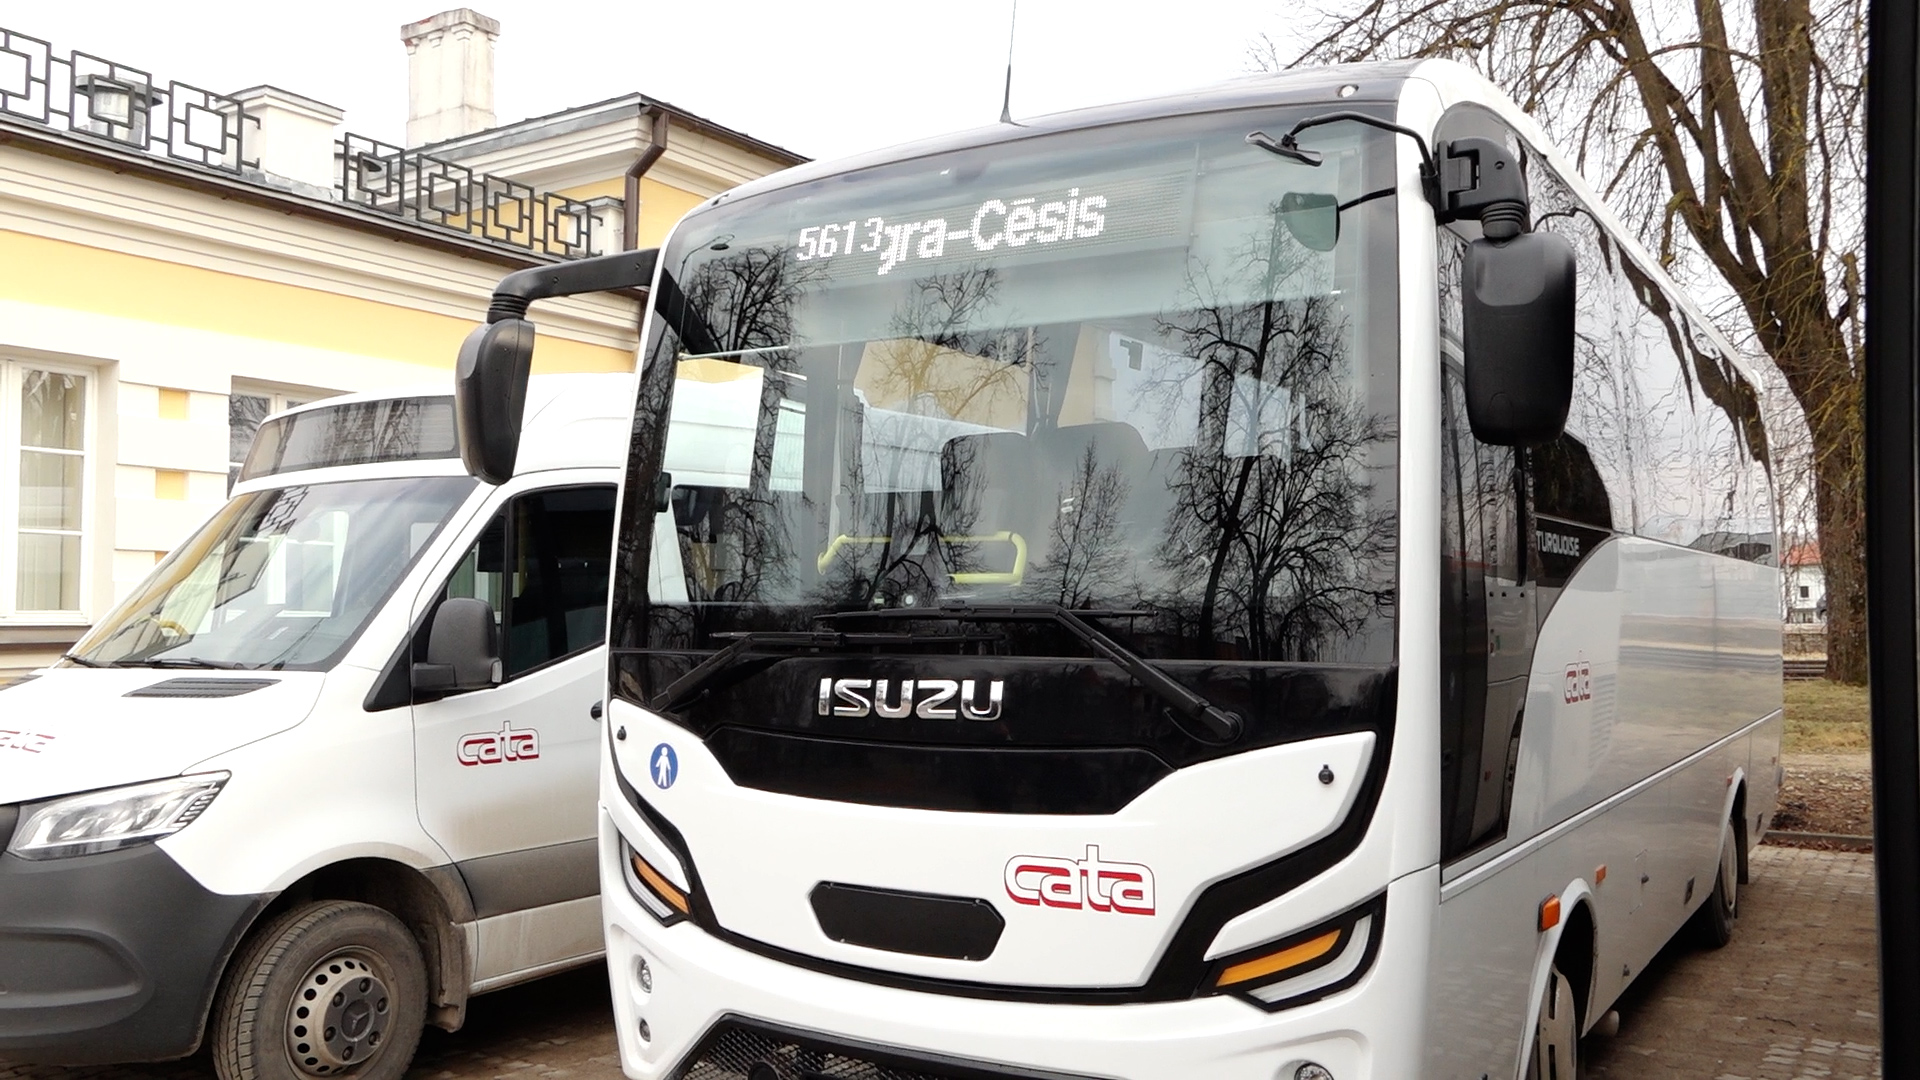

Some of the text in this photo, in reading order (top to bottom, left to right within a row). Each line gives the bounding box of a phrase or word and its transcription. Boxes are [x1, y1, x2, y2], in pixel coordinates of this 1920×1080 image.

[797, 216, 884, 261] 5613
[1536, 530, 1580, 557] TURQUOISE
[818, 677, 1004, 721] ISUZU
[1563, 650, 1591, 705] cata
[456, 720, 540, 767] cata
[1003, 844, 1156, 916] cata
